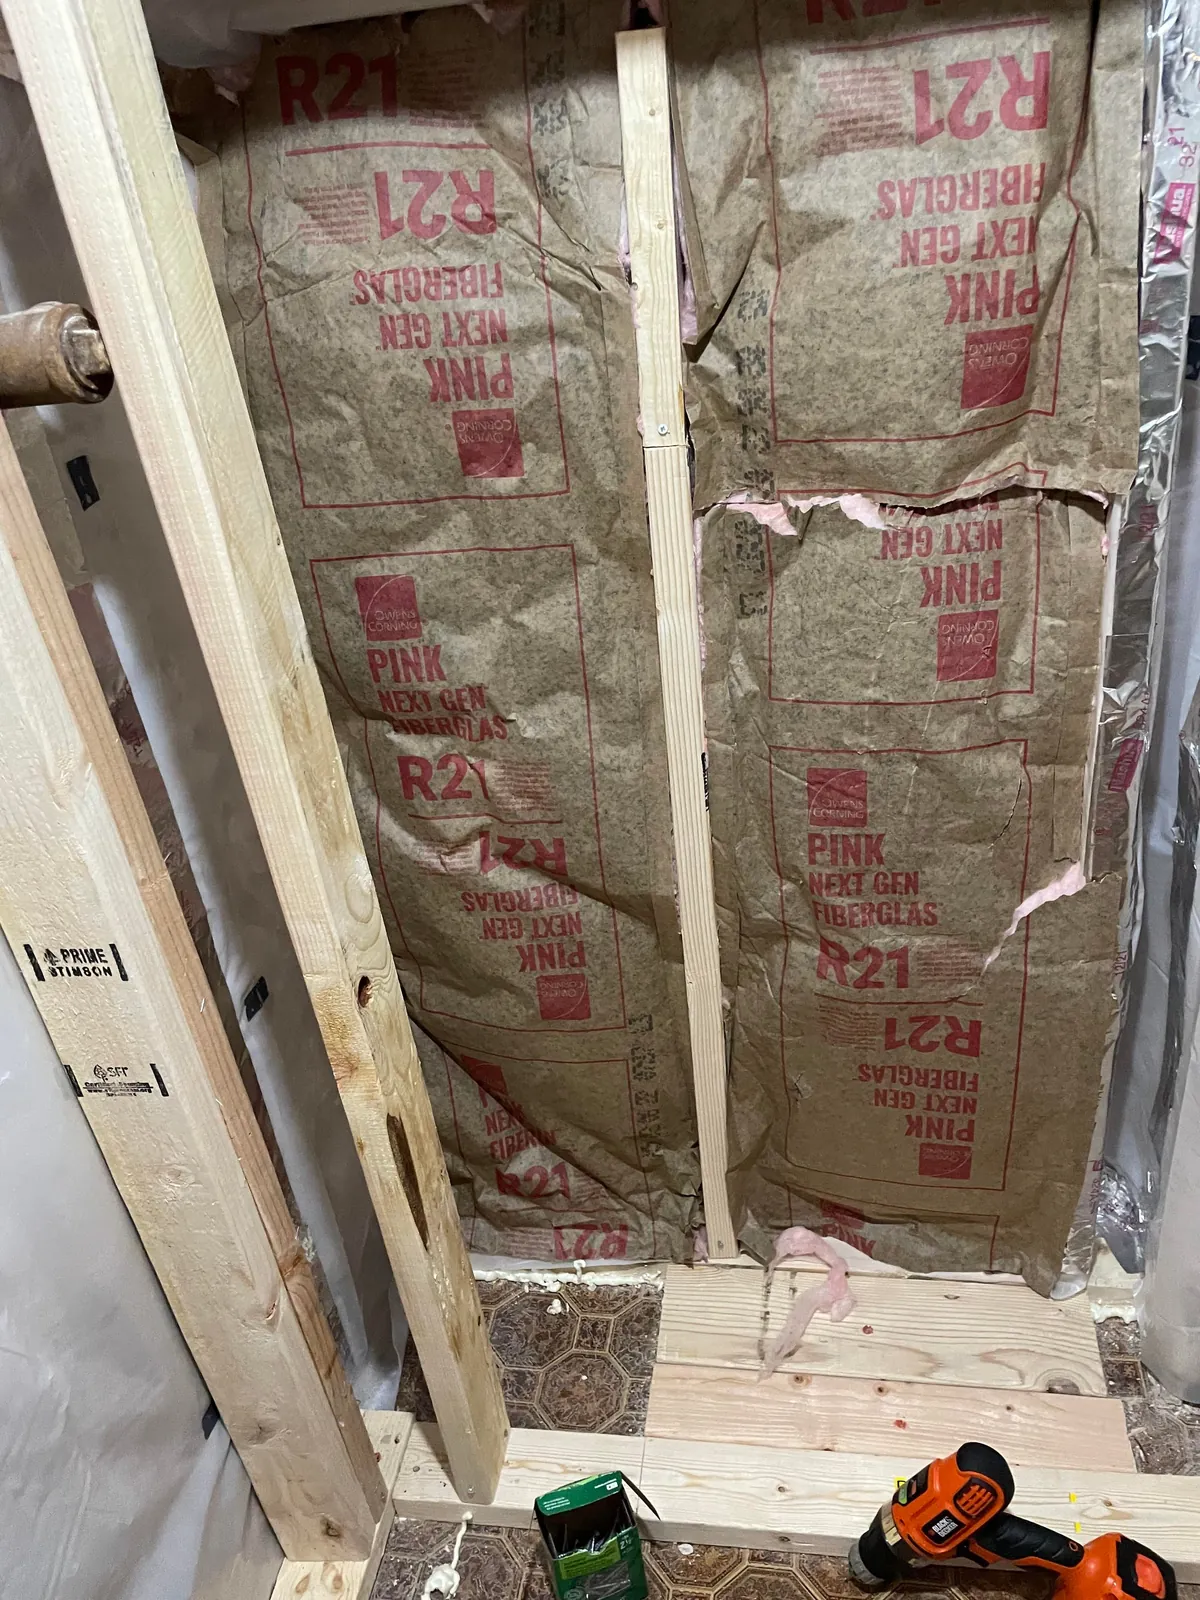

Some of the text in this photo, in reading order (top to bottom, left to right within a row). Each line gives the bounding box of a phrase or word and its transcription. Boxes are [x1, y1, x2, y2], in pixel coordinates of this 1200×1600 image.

[275, 52, 398, 126] R21
[913, 50, 1051, 145] R21
[374, 169, 498, 242] R21
[876, 162, 1046, 222] FIBERGLAS
[900, 225, 963, 268] GEN
[353, 261, 504, 306] FIBERGLAS
[943, 264, 1040, 326] PINK
[378, 308, 509, 350] NEXT GEN
[968, 336, 1029, 355] CORNING
[422, 352, 515, 403] PINK
[456, 418, 512, 433] CORNING
[881, 518, 1003, 560] NEXT GEN
[920, 559, 1002, 608] PINK
[368, 619, 418, 634] CORNING
[366, 644, 447, 684] PINK
[377, 684, 487, 713] NEXT GEN
[391, 714, 508, 742] FIBERGLAS
[397, 753, 490, 801] R21
[812, 807, 864, 819] CORNING
[478, 830, 569, 876] R21
[807, 833, 886, 867] PINK
[460, 882, 579, 913] FIBERGLAS
[809, 870, 919, 896] NEXT GEN
[482, 911, 583, 941] NEXT GEN
[813, 901, 938, 929] FIBERGLAS
[60, 948, 109, 964] PRIME
[515, 940, 587, 973] PINK
[816, 934, 909, 989] R21
[884, 1014, 982, 1058] R21
[857, 1063, 979, 1093] FIBERGLAS
[873, 1088, 978, 1114] NEXT GEN
[904, 1114, 976, 1142] PINK
[553, 1223, 629, 1260] R21
